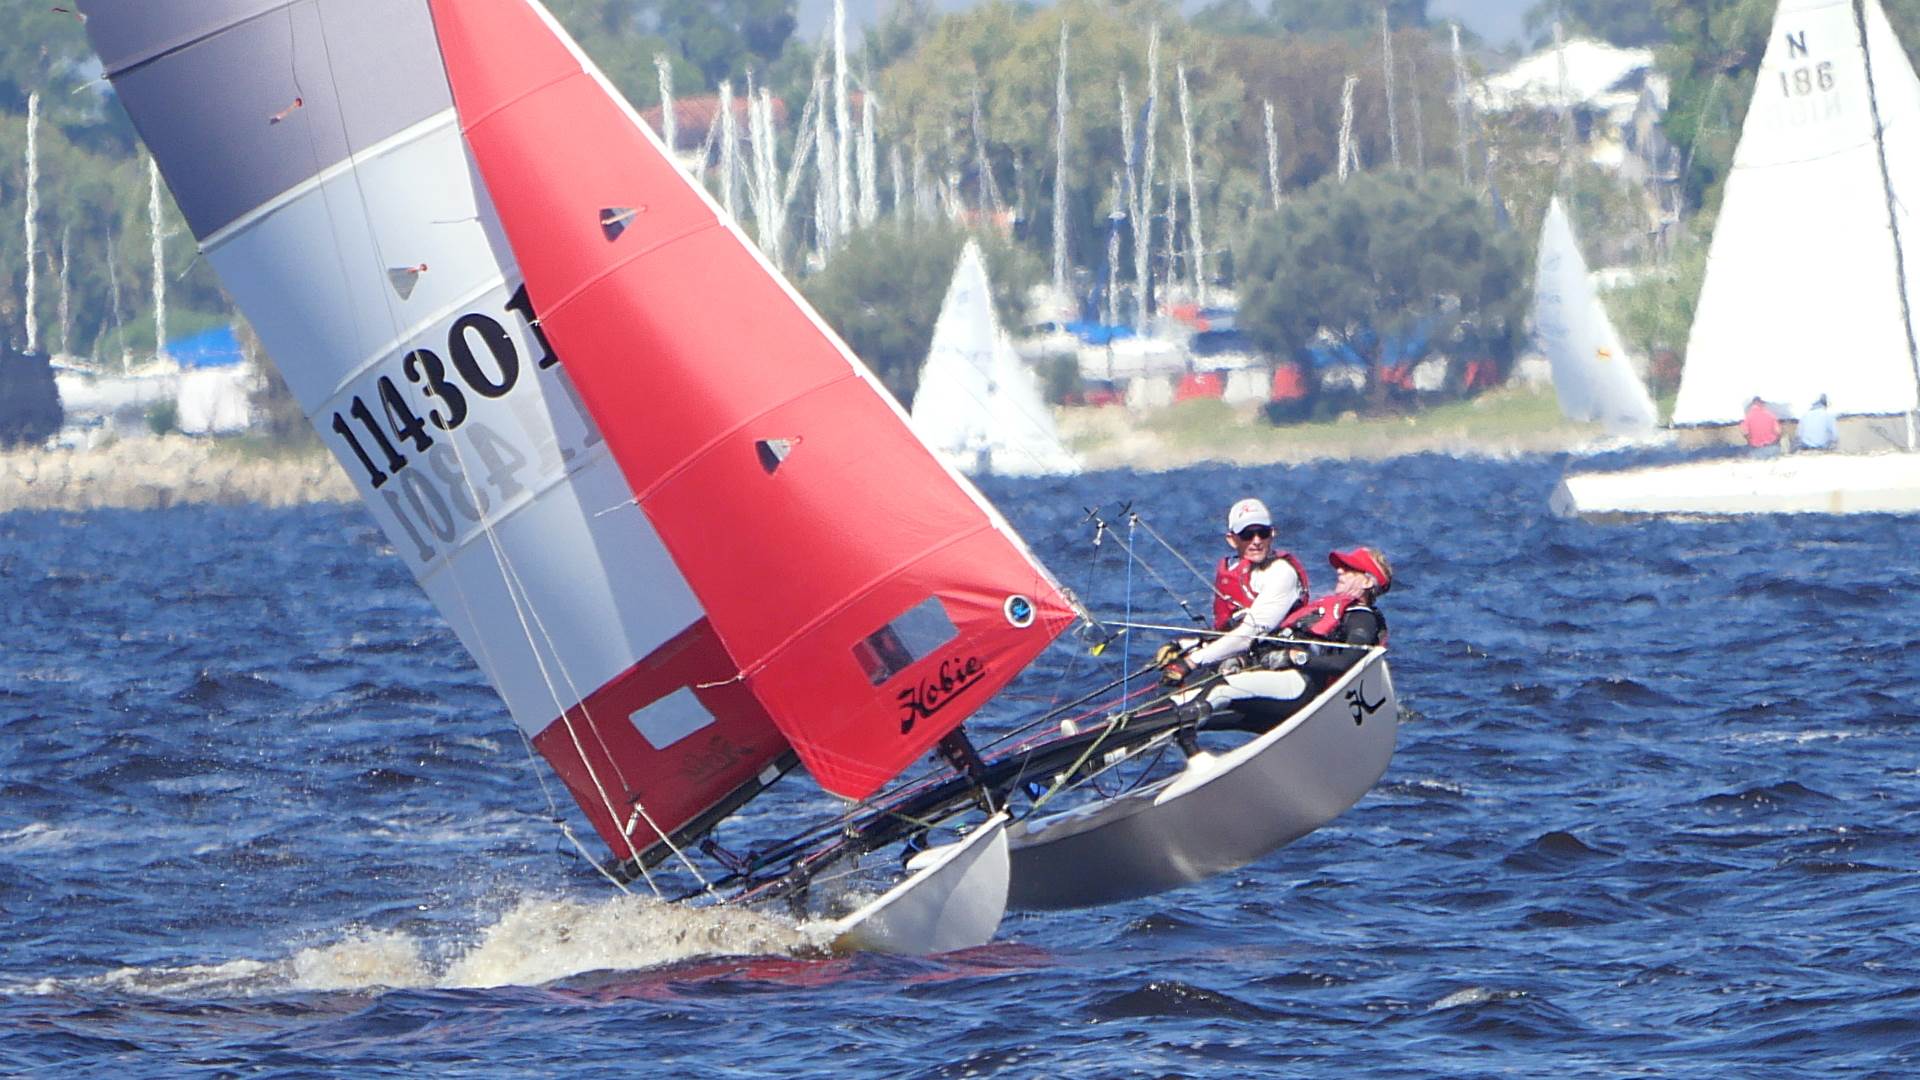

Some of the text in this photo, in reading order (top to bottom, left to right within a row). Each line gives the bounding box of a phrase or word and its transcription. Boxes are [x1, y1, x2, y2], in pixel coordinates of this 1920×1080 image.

[1786, 30, 1808, 59] N
[1779, 61, 1834, 98] 186
[333, 283, 559, 488] 114301
[897, 655, 986, 734] Hobie
